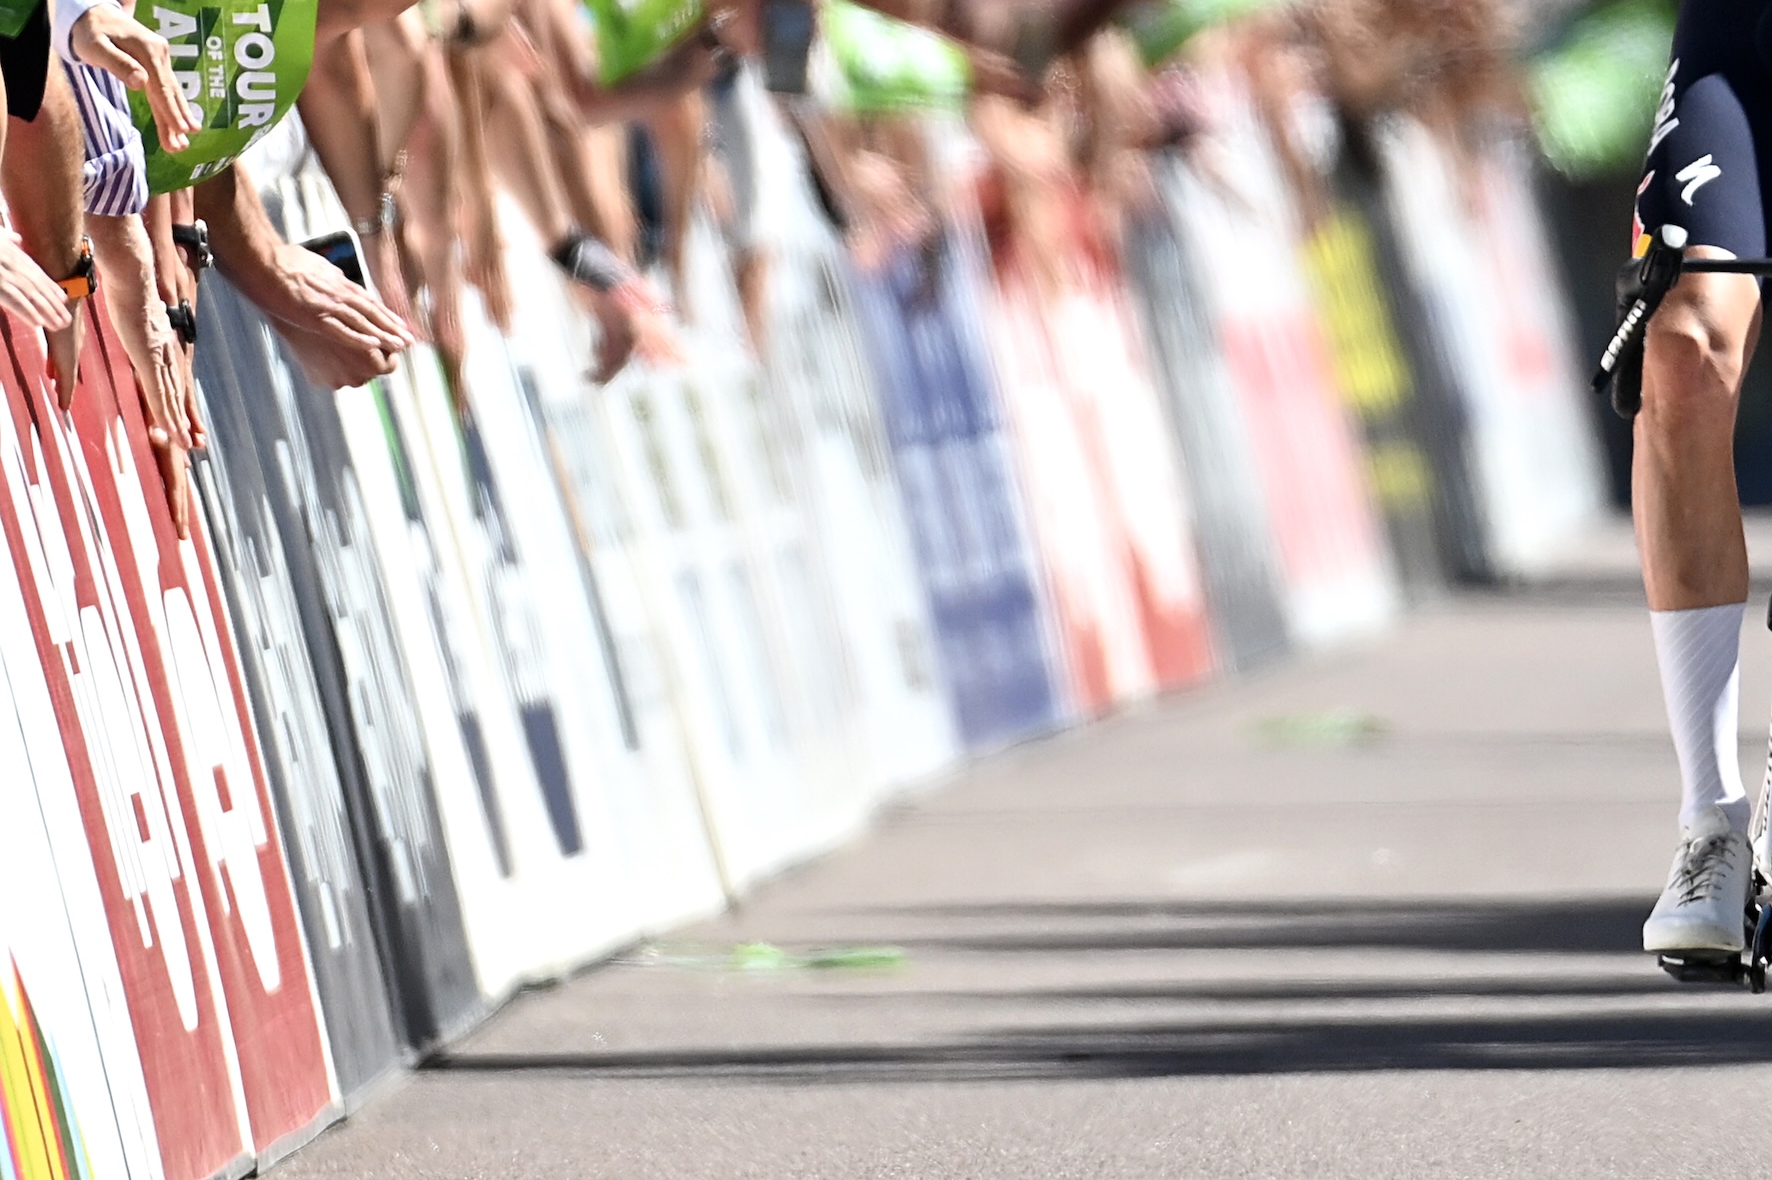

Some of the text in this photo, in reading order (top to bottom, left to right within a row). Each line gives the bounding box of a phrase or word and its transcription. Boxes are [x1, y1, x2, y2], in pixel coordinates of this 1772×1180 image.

[206, 36, 226, 99] OF THE
[232, 3, 276, 130] TOUR
